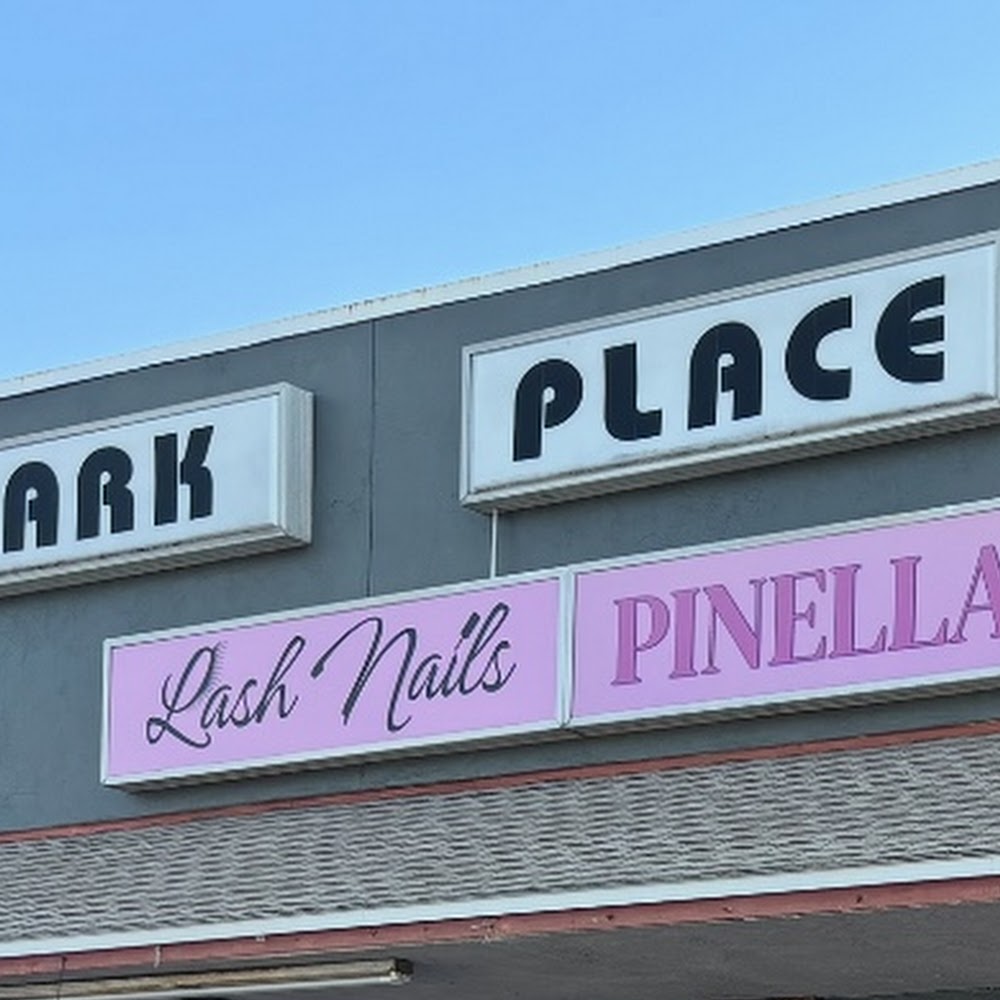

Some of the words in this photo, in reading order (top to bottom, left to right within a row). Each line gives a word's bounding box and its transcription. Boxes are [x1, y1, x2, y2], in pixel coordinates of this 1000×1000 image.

[512, 274, 946, 461] PLACE
[2, 425, 214, 553] ARK
[146, 636, 305, 749] Lash
[310, 602, 517, 732] Nails
